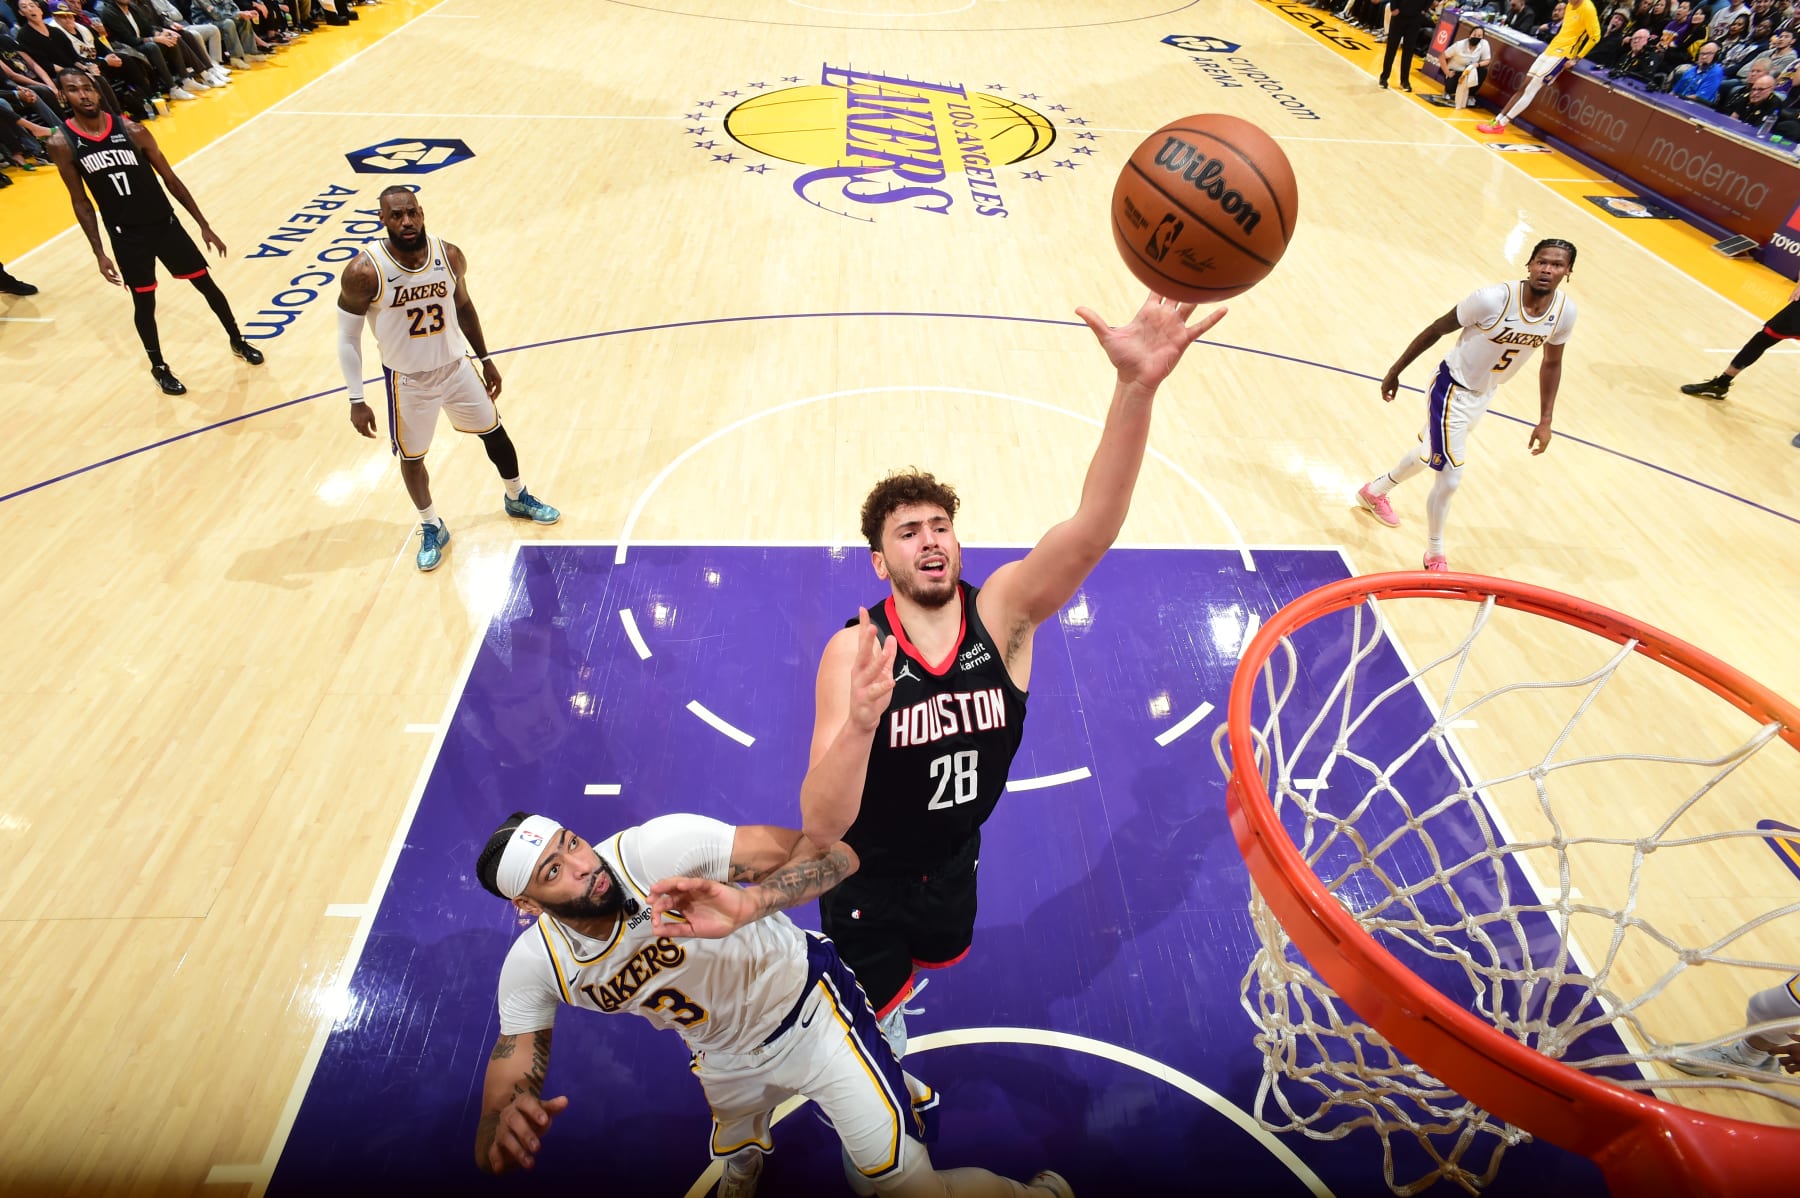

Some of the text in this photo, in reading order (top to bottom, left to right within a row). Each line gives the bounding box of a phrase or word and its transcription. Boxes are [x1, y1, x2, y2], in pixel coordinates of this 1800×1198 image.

[1277, 5, 1372, 50] LEXUS
[1188, 56, 1243, 88] ARENA
[1227, 56, 1321, 120] crypto.com
[1491, 60, 1527, 90] erna
[1541, 85, 1629, 142] moderna
[79, 149, 139, 174] HOUSTON
[793, 62, 968, 223] LAKERS
[947, 102, 1009, 218] LOS ANGELES
[108, 171, 132, 196] 17
[1154, 136, 1262, 236] Wilson
[1648, 136, 1770, 210] moderna
[244, 184, 360, 259] ARENA
[1770, 232, 1800, 257] TOYO
[389, 280, 448, 308] LAKERS
[406, 303, 446, 339] 23
[1488, 327, 1548, 348] LAKERS
[1490, 349, 1520, 373] 5
[889, 688, 1006, 748] HOUSTON
[928, 750, 978, 811] 28
[627, 907, 652, 930] bibigo
[581, 936, 687, 1013] LAKERS
[641, 986, 709, 1030] 3
